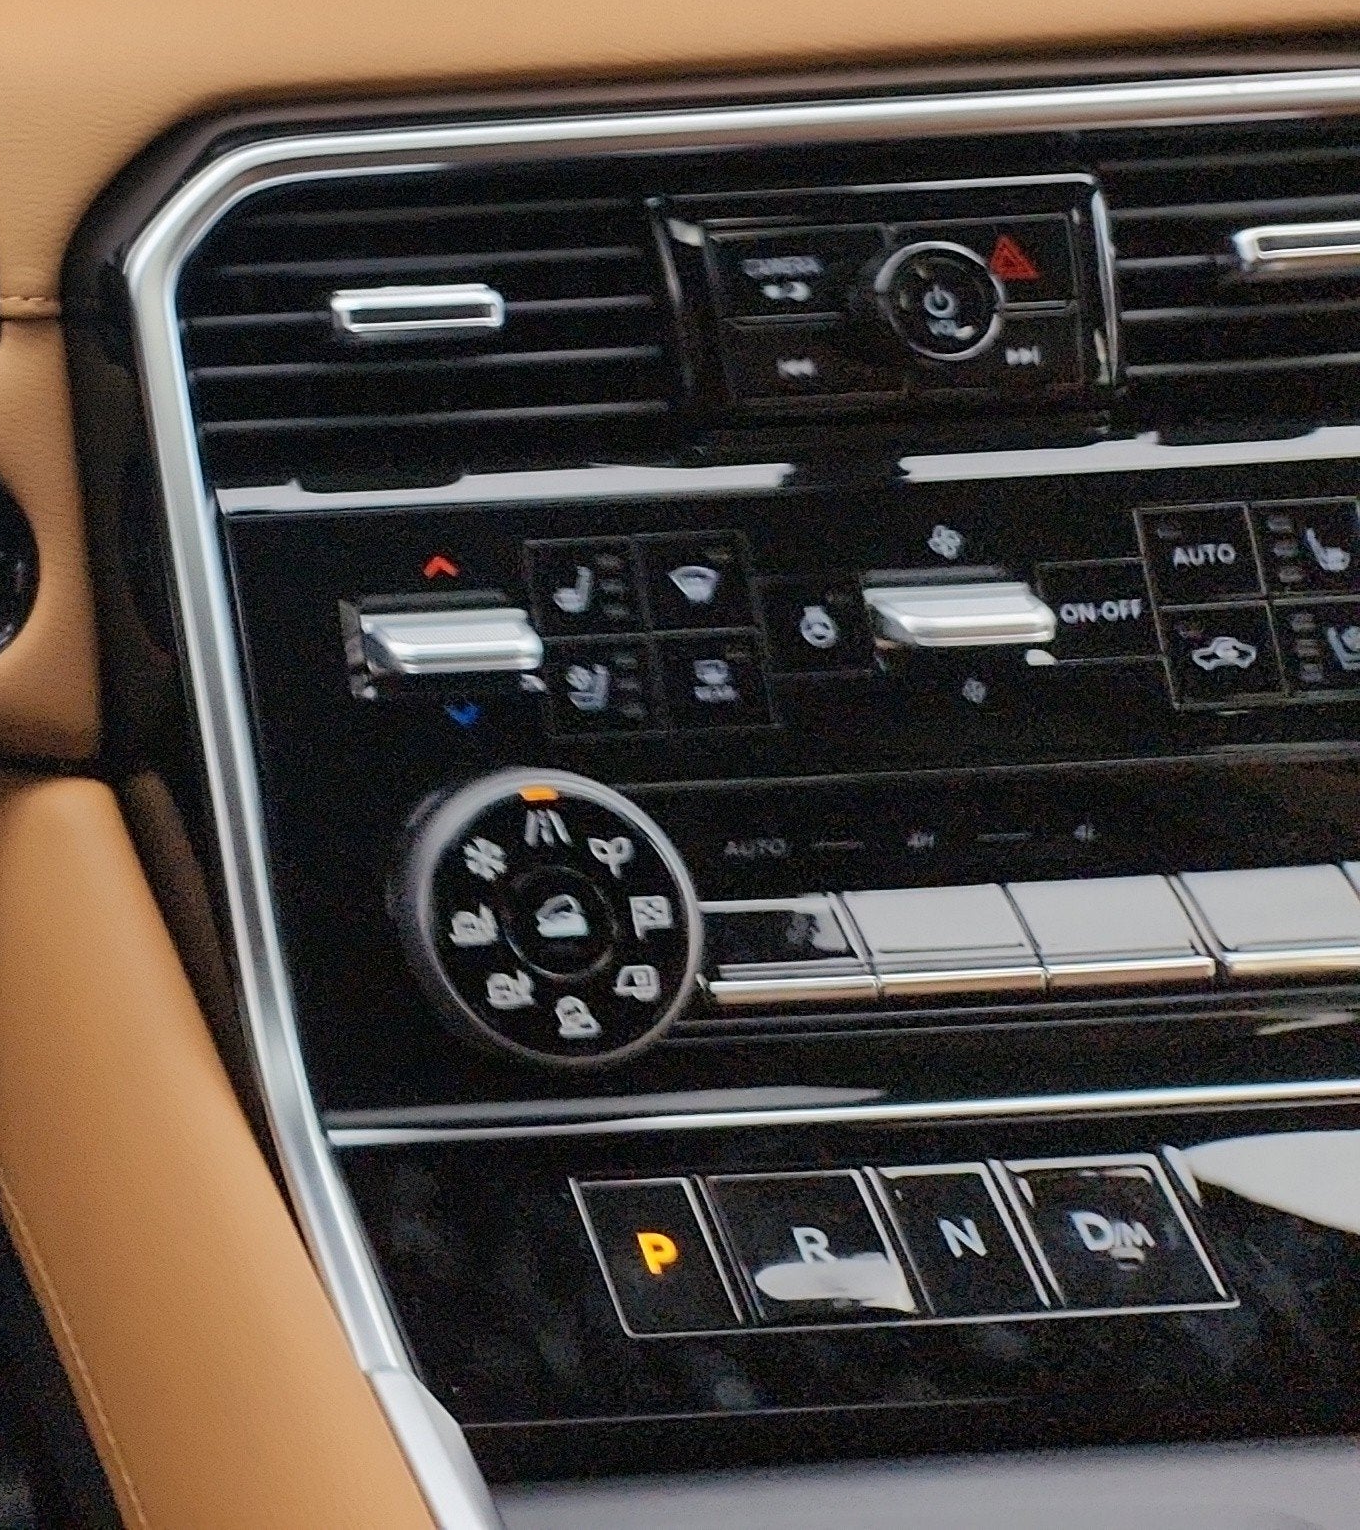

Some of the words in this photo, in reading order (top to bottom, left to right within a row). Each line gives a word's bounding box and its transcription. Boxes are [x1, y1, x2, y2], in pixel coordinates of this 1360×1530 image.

[1173, 543, 1235, 566] AUTO
[725, 837, 787, 859] AUTO
[636, 1231, 679, 1275] P
[791, 1226, 837, 1264] R
[937, 1217, 989, 1258] N
